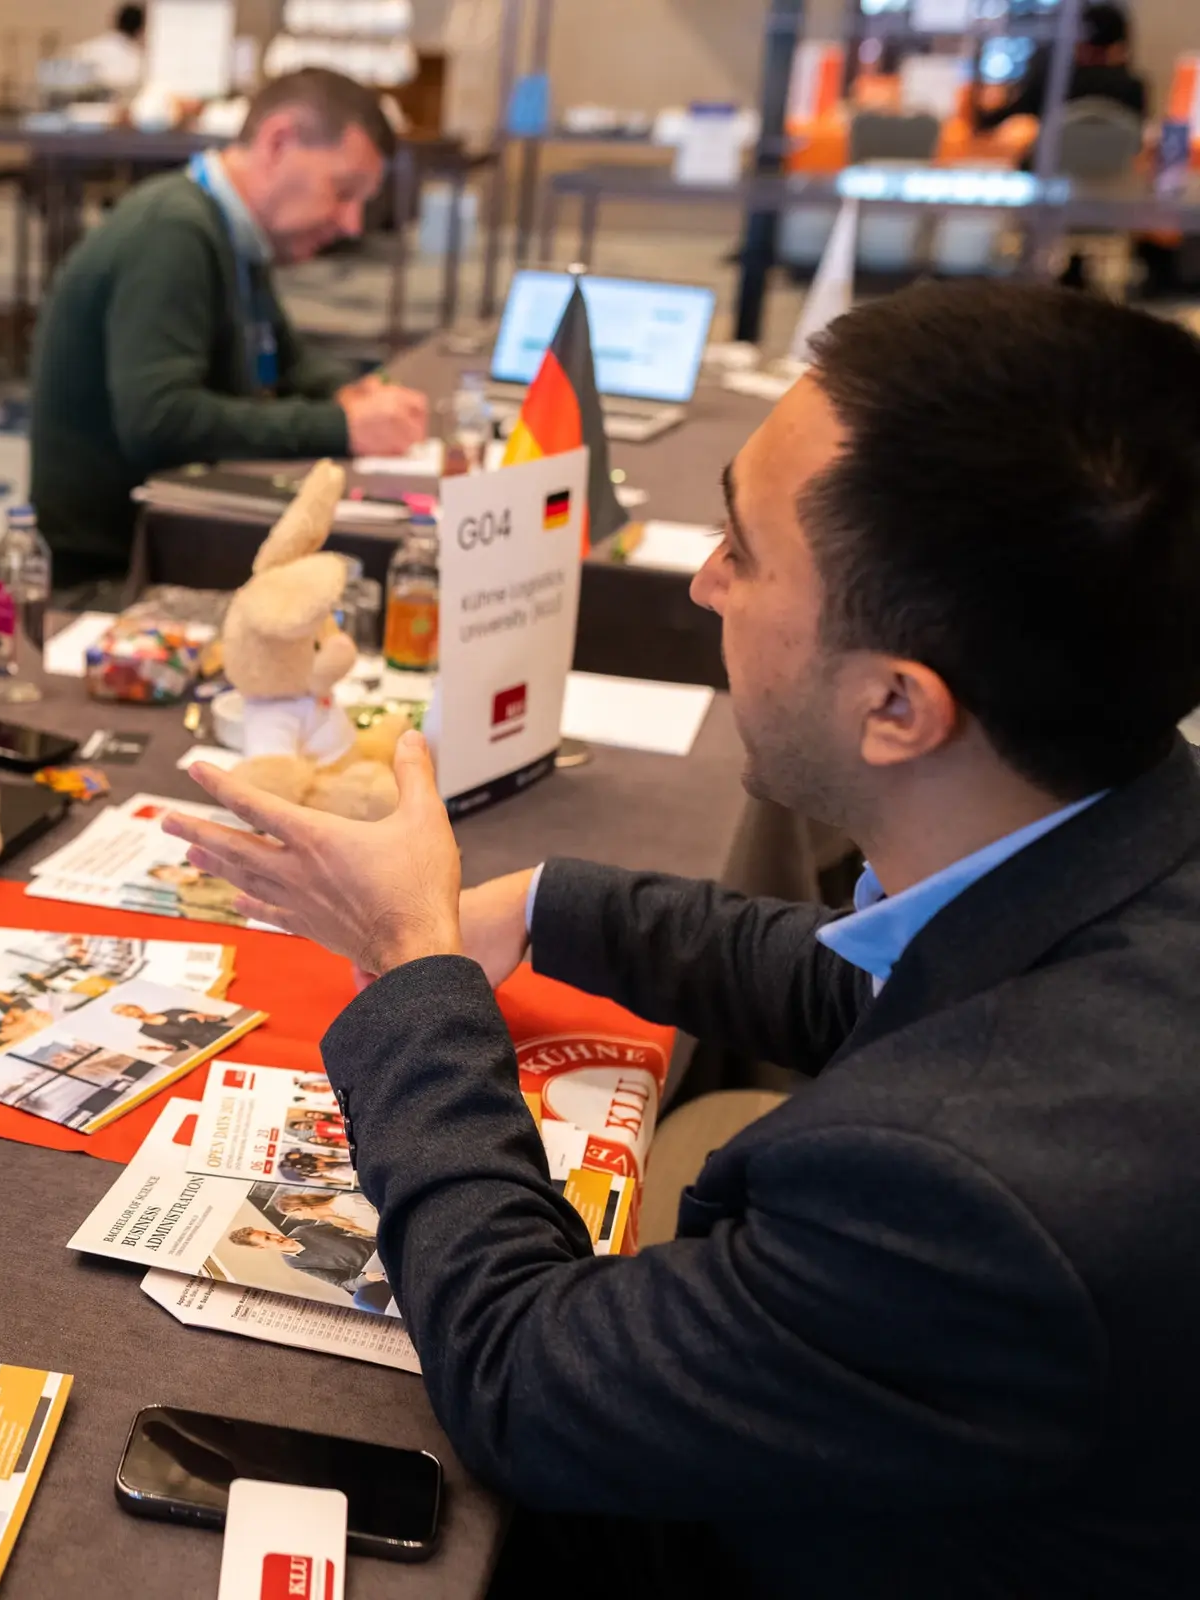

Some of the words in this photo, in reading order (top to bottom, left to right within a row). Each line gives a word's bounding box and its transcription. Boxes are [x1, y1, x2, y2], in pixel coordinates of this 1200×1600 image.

[457, 508, 513, 551] G04
[520, 1042, 647, 1076] KÜHNE
[605, 1077, 650, 1141] KLU
[103, 1208, 136, 1243] BACHELOR
[129, 1199, 142, 1211] OF
[136, 1175, 161, 1202] SCIENCE
[121, 1205, 162, 1247] BUSINESS
[144, 1175, 206, 1252] ADMINISTRATION
[288, 1555, 308, 1597] KLU
